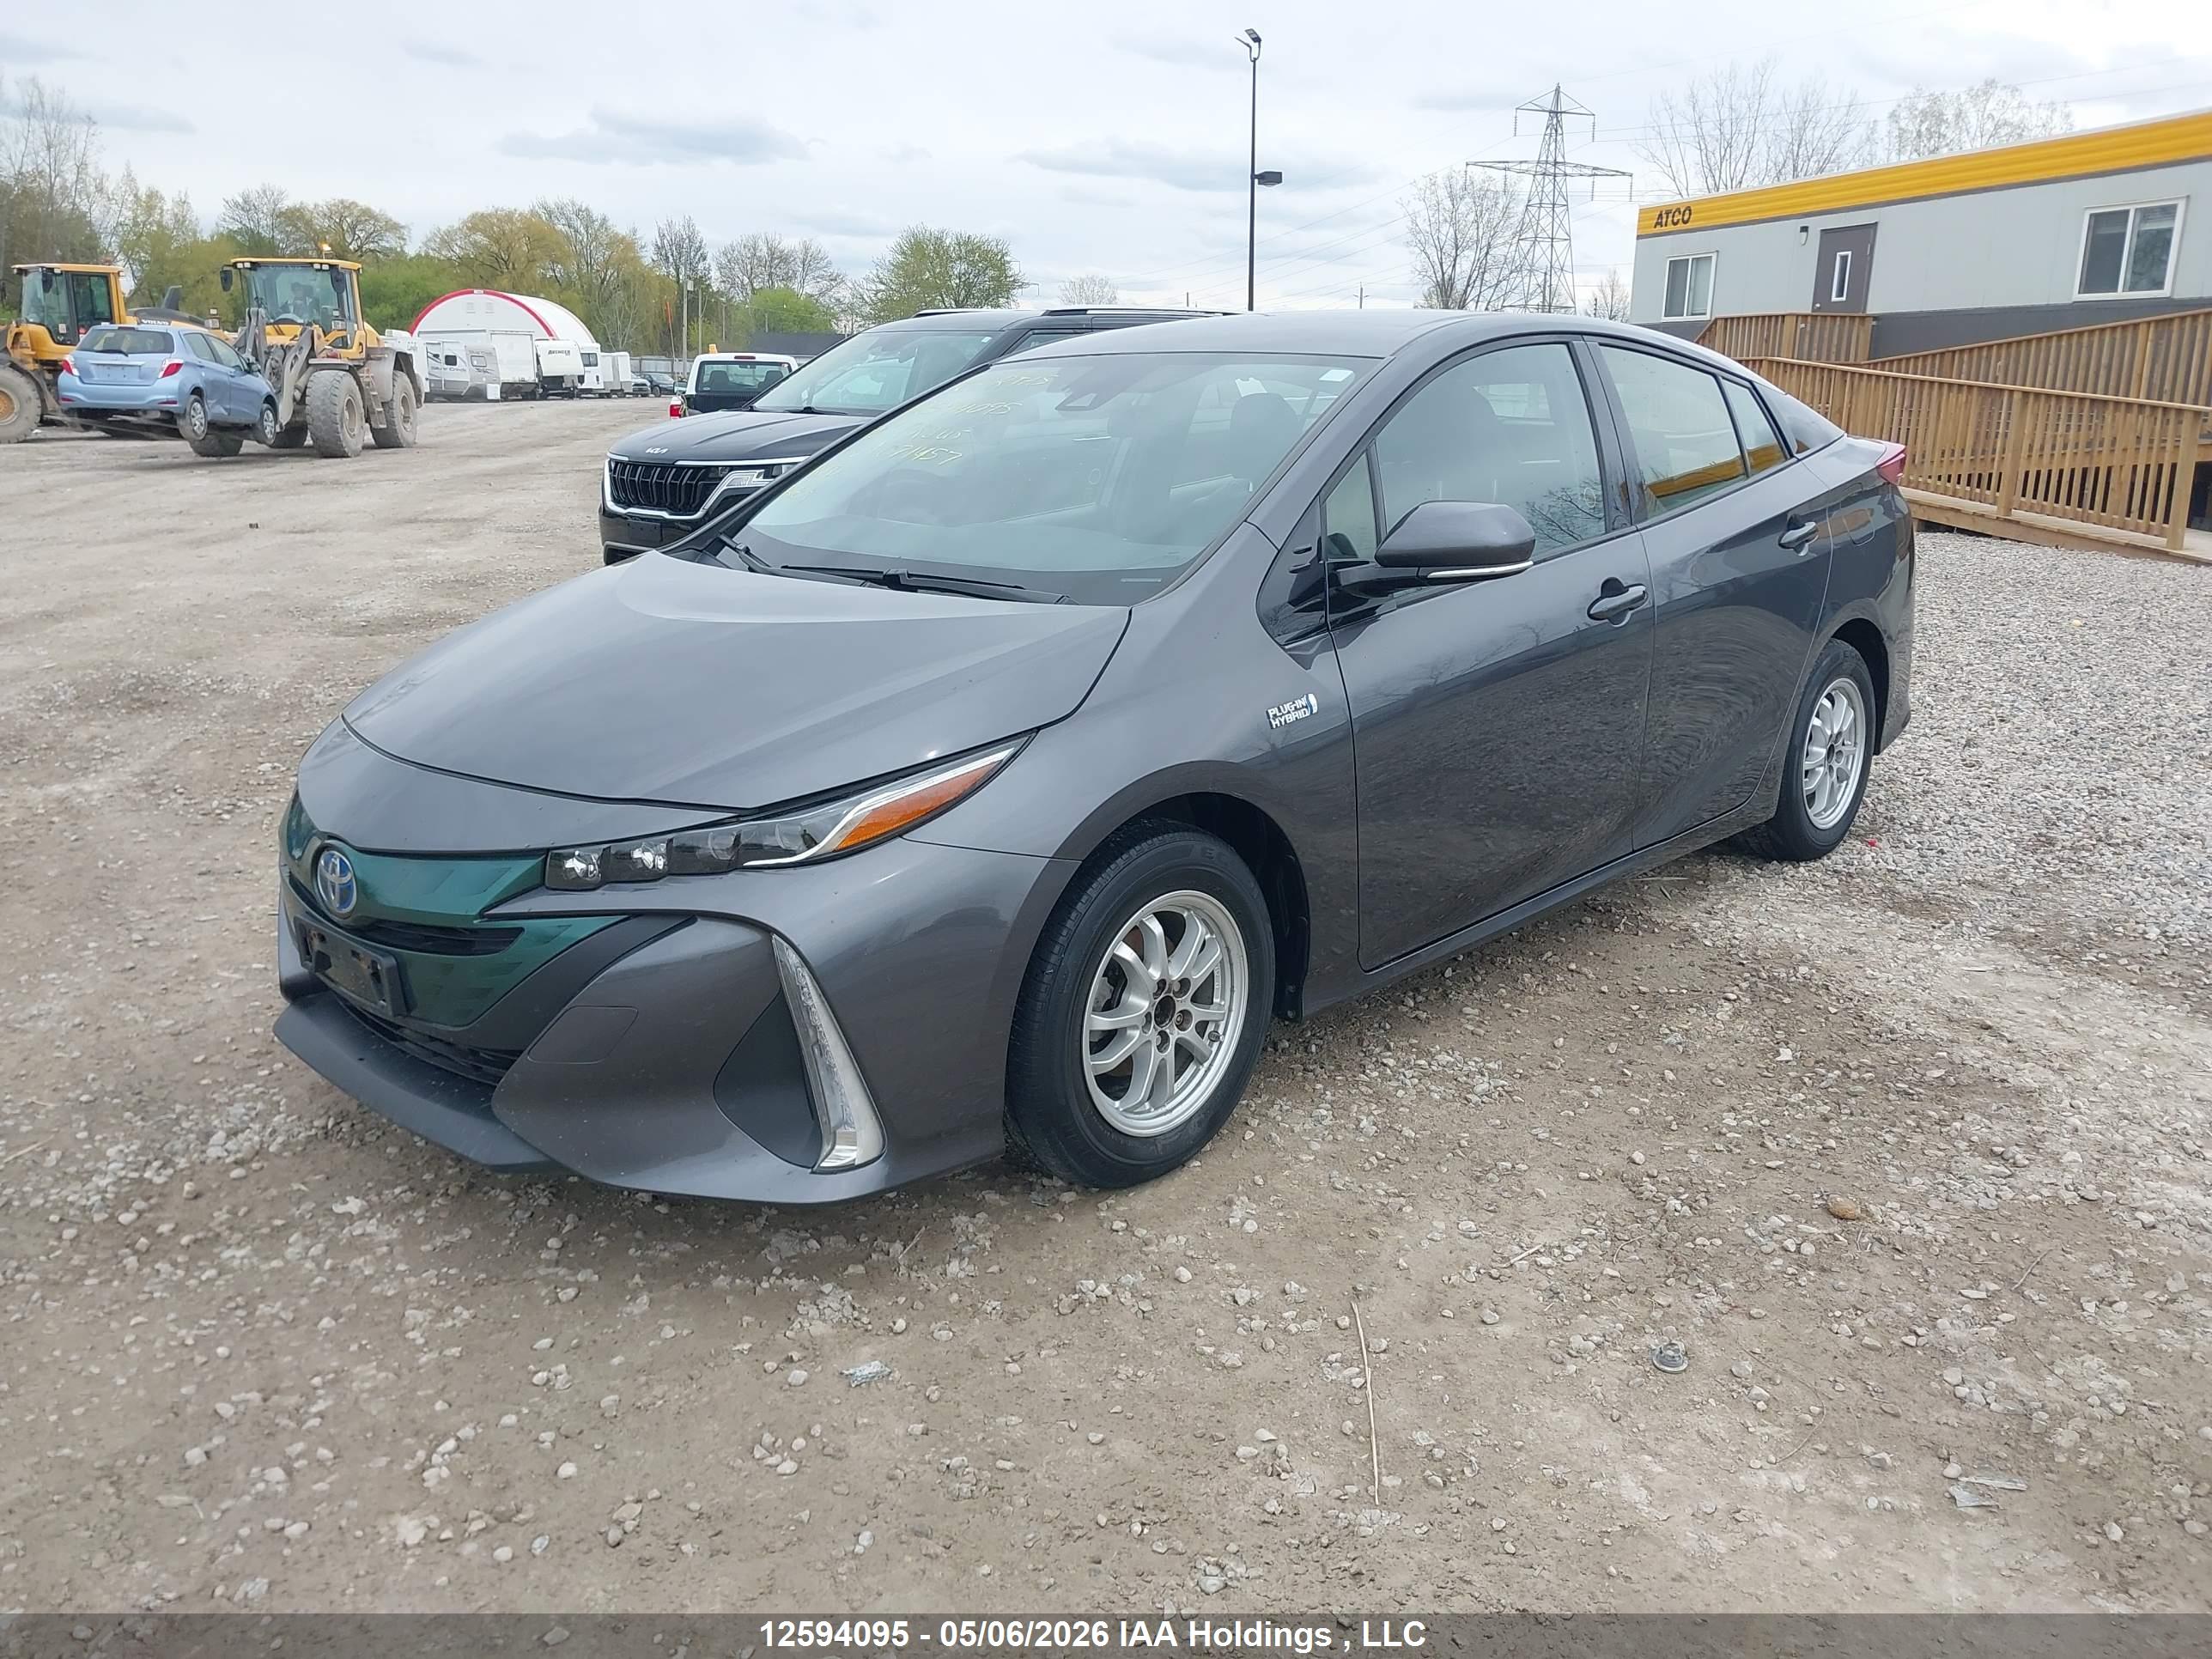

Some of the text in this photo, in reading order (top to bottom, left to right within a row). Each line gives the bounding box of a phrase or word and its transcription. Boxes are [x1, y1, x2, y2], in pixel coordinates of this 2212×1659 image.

[1654, 206, 1692, 228] ATCO
[1267, 696, 1306, 718] PLUG-IN
[1270, 708, 1310, 729] HYBRID
